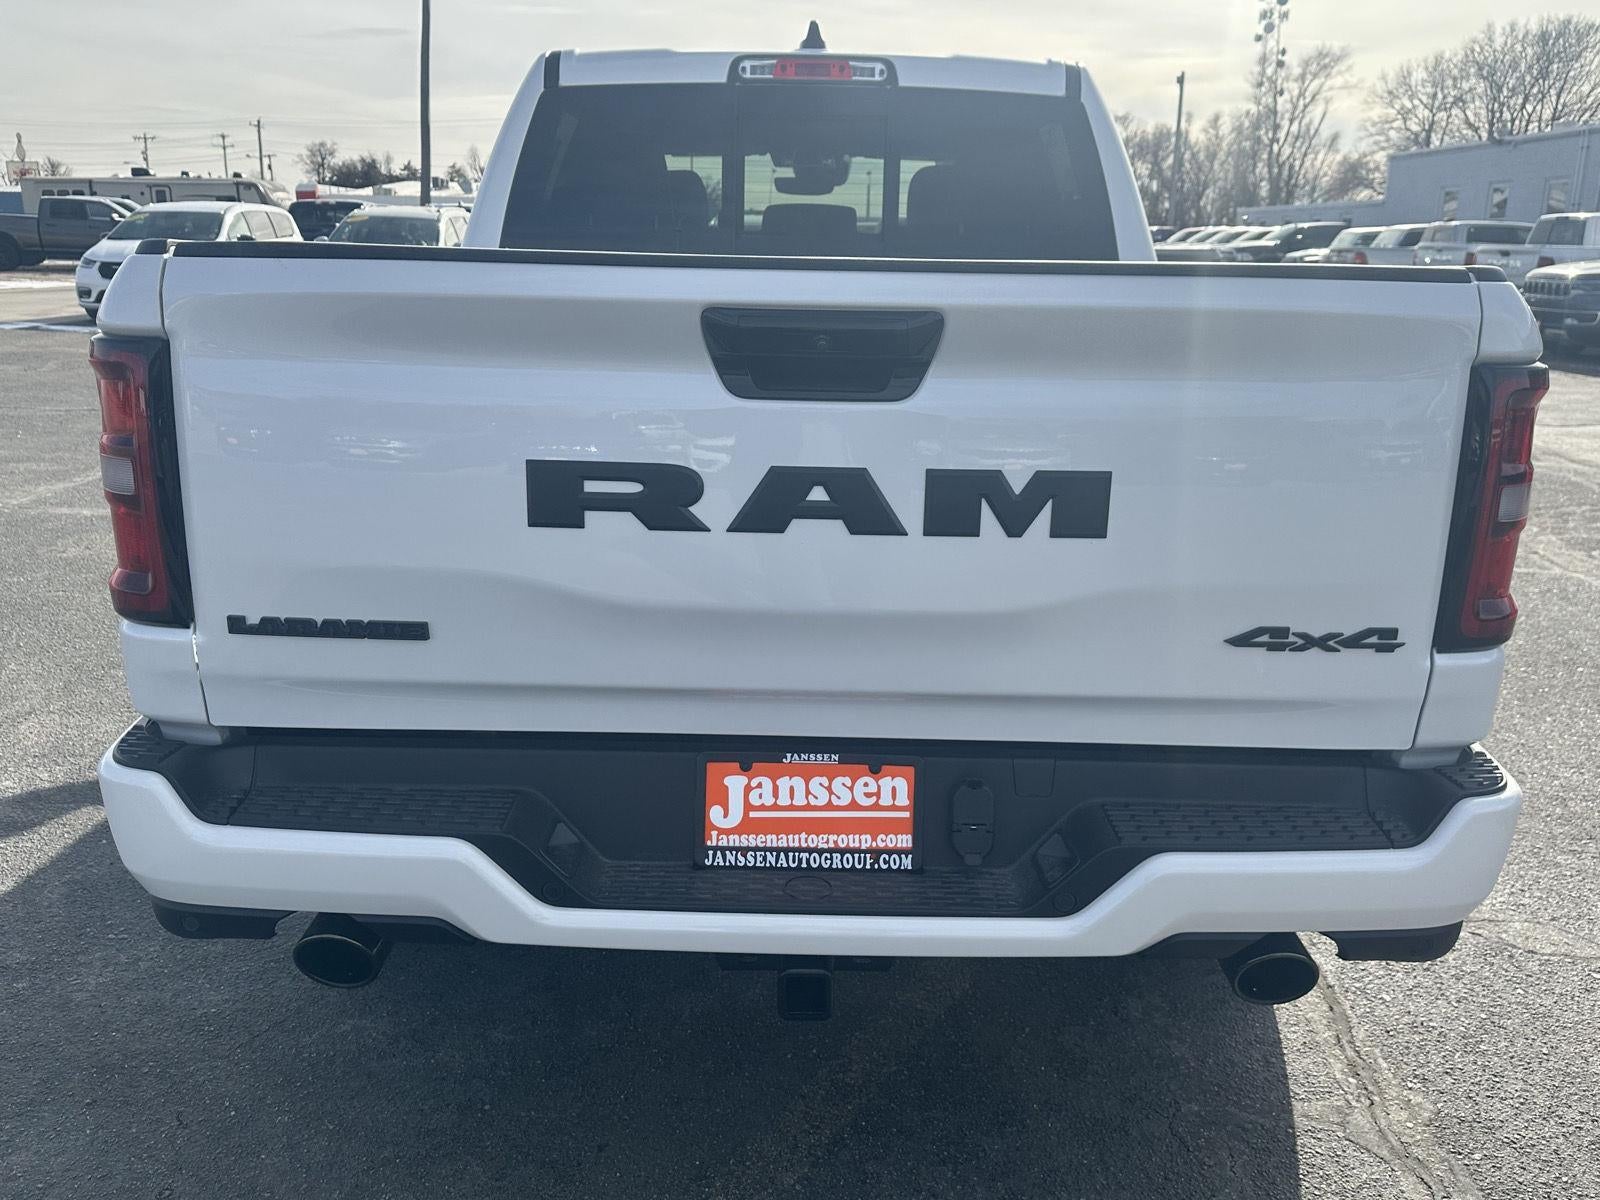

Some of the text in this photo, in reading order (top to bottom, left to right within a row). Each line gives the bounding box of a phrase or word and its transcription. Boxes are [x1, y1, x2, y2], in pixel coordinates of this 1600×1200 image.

[525, 459, 1112, 538] RAM
[1223, 626, 1406, 653] 4x4
[782, 753, 839, 763] JANSSEN
[709, 775, 910, 829] Janssen
[706, 830, 912, 850] Janssenautogroup.com
